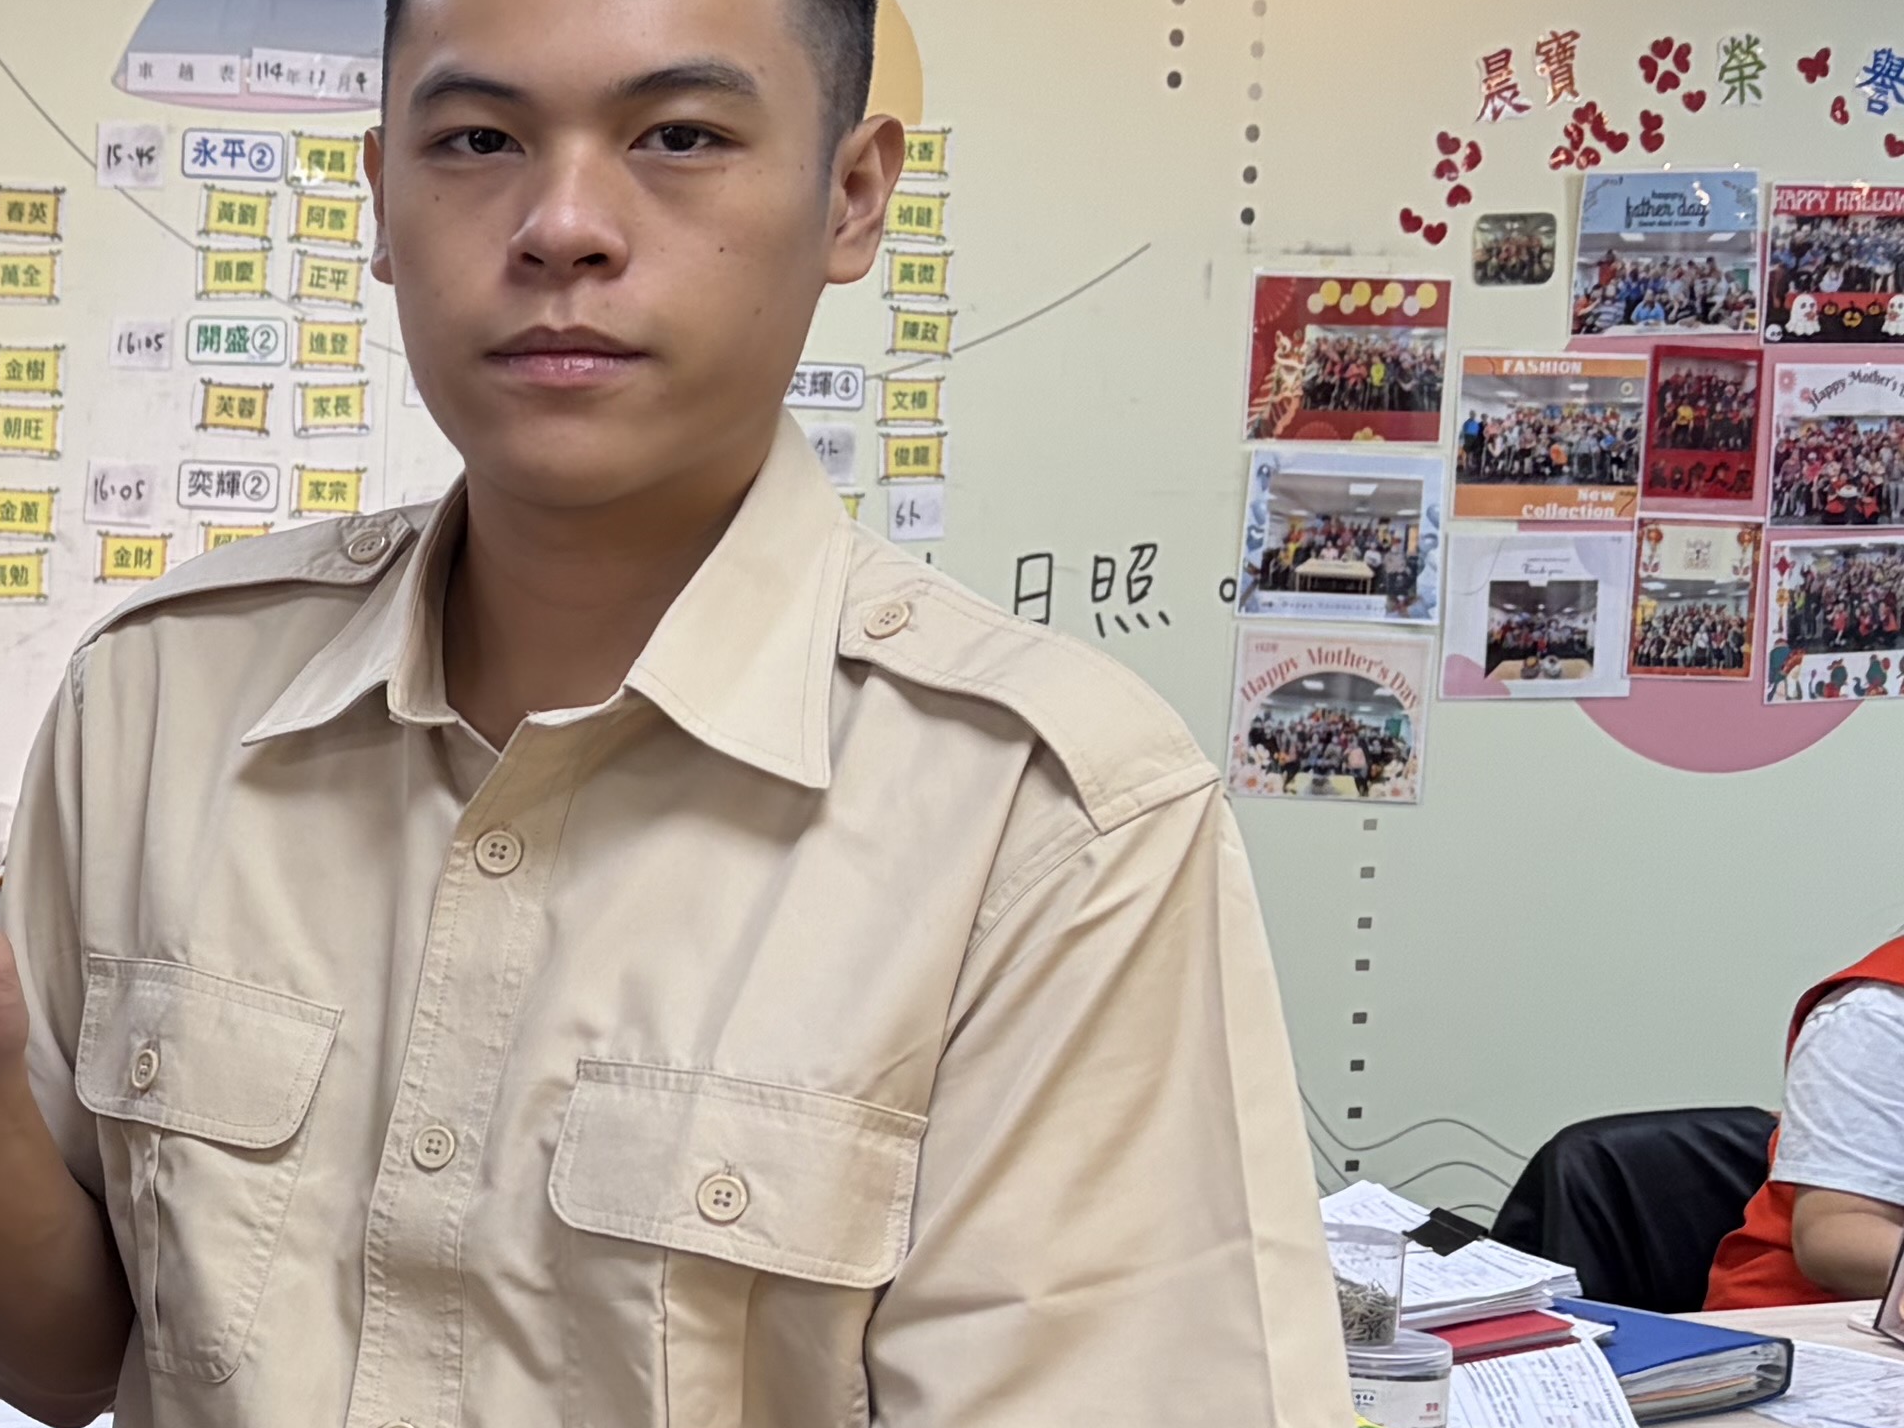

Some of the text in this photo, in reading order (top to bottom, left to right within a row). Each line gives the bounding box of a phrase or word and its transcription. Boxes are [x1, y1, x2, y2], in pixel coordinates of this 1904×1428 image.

[1476, 28, 1582, 124] 晨寶
[1774, 186, 1830, 213] HAPPY
[6, 201, 49, 225] 春英
[0, 263, 43, 288] 萬全
[213, 256, 255, 284] 順慶
[307, 263, 349, 291] 正平
[308, 329, 349, 355] 進登
[902, 319, 939, 343] 陳政
[5, 359, 46, 383] 金樹
[1502, 359, 1583, 375] FASHION
[215, 393, 257, 420] 芙蓉
[311, 392, 353, 419] 家長
[3, 416, 44, 441] 朝旺
[308, 475, 348, 503] 家宗
[1577, 489, 1616, 503] New
[1521, 504, 1616, 519] Collection
[113, 542, 155, 571] 金財
[1241, 646, 1420, 710] Happy Mother's Day
